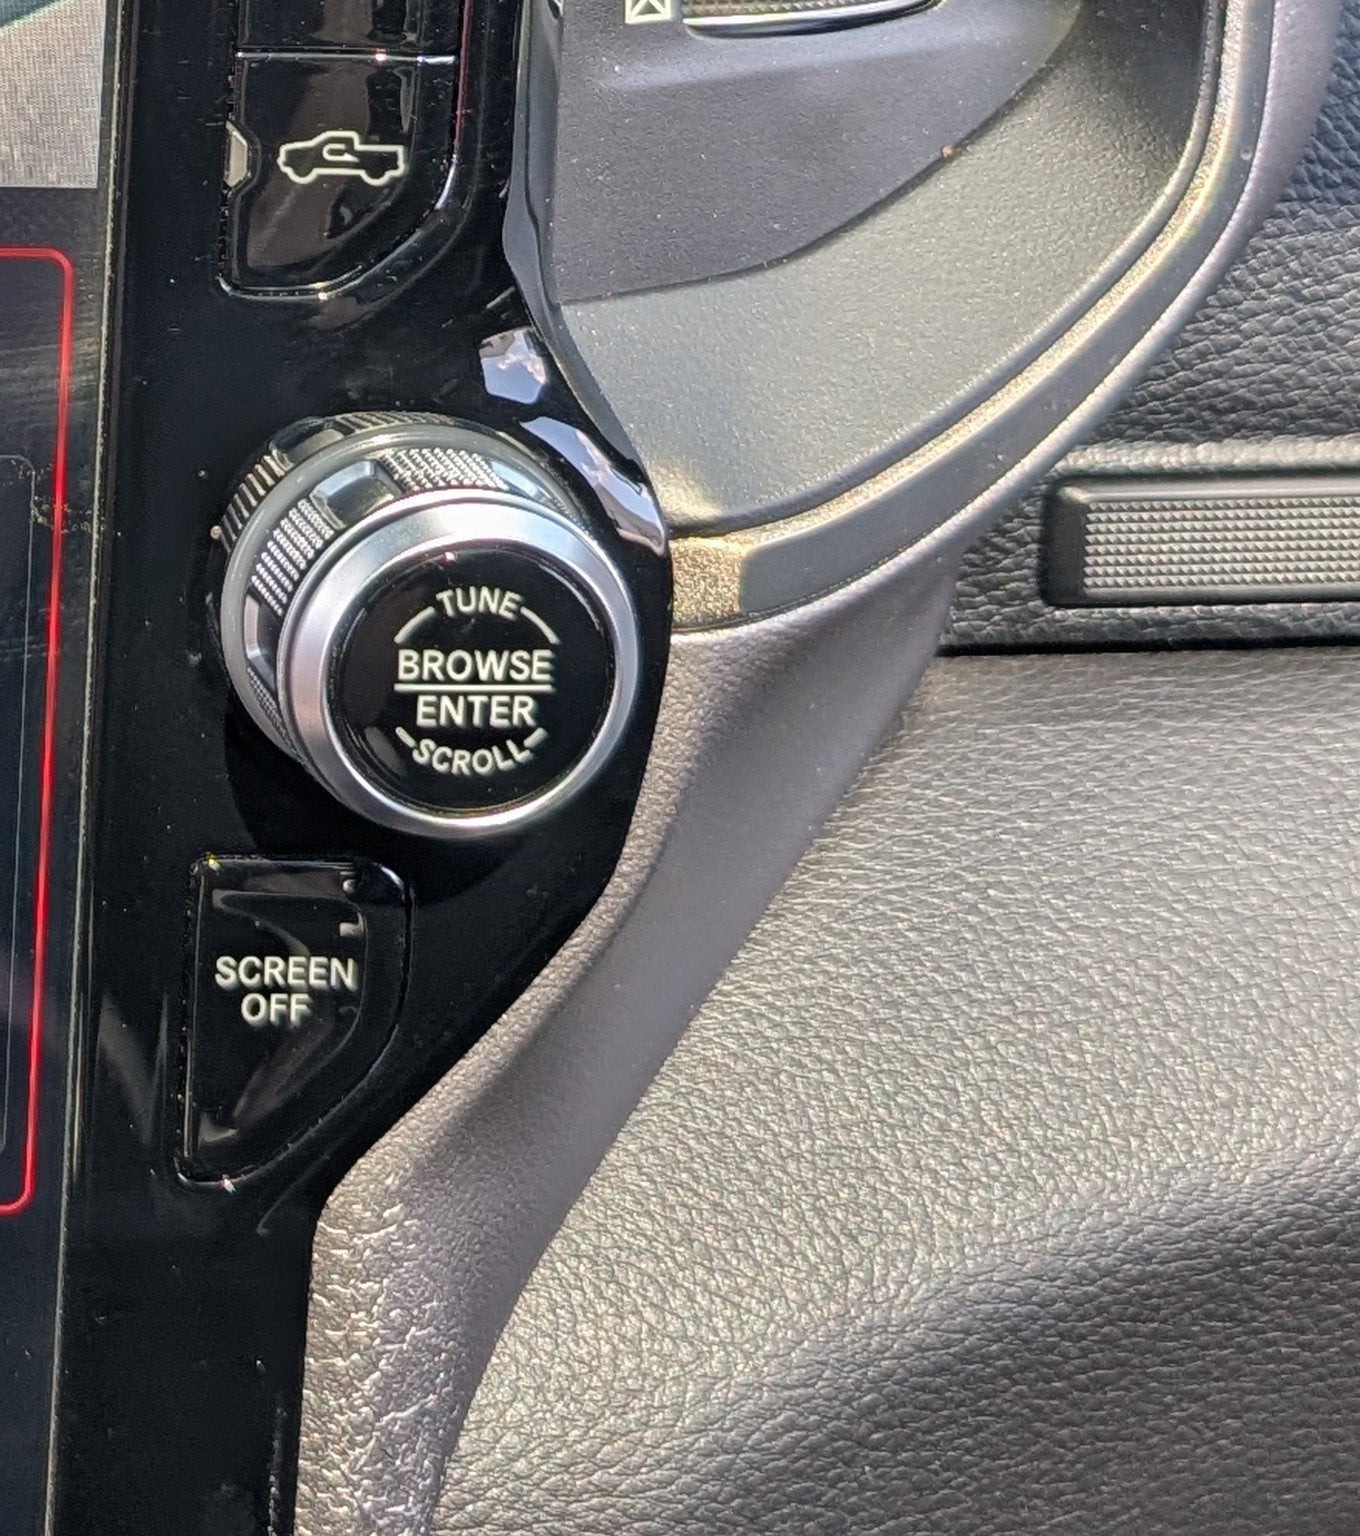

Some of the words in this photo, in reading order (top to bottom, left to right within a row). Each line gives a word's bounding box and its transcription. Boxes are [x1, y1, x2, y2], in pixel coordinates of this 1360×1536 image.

[436, 586, 523, 621] TUNE
[397, 649, 556, 682] BROWSE
[416, 695, 538, 728] ENTER
[411, 738, 533, 775] SCROLL
[214, 955, 357, 991] SCREEN
[241, 993, 312, 1028] OFF
